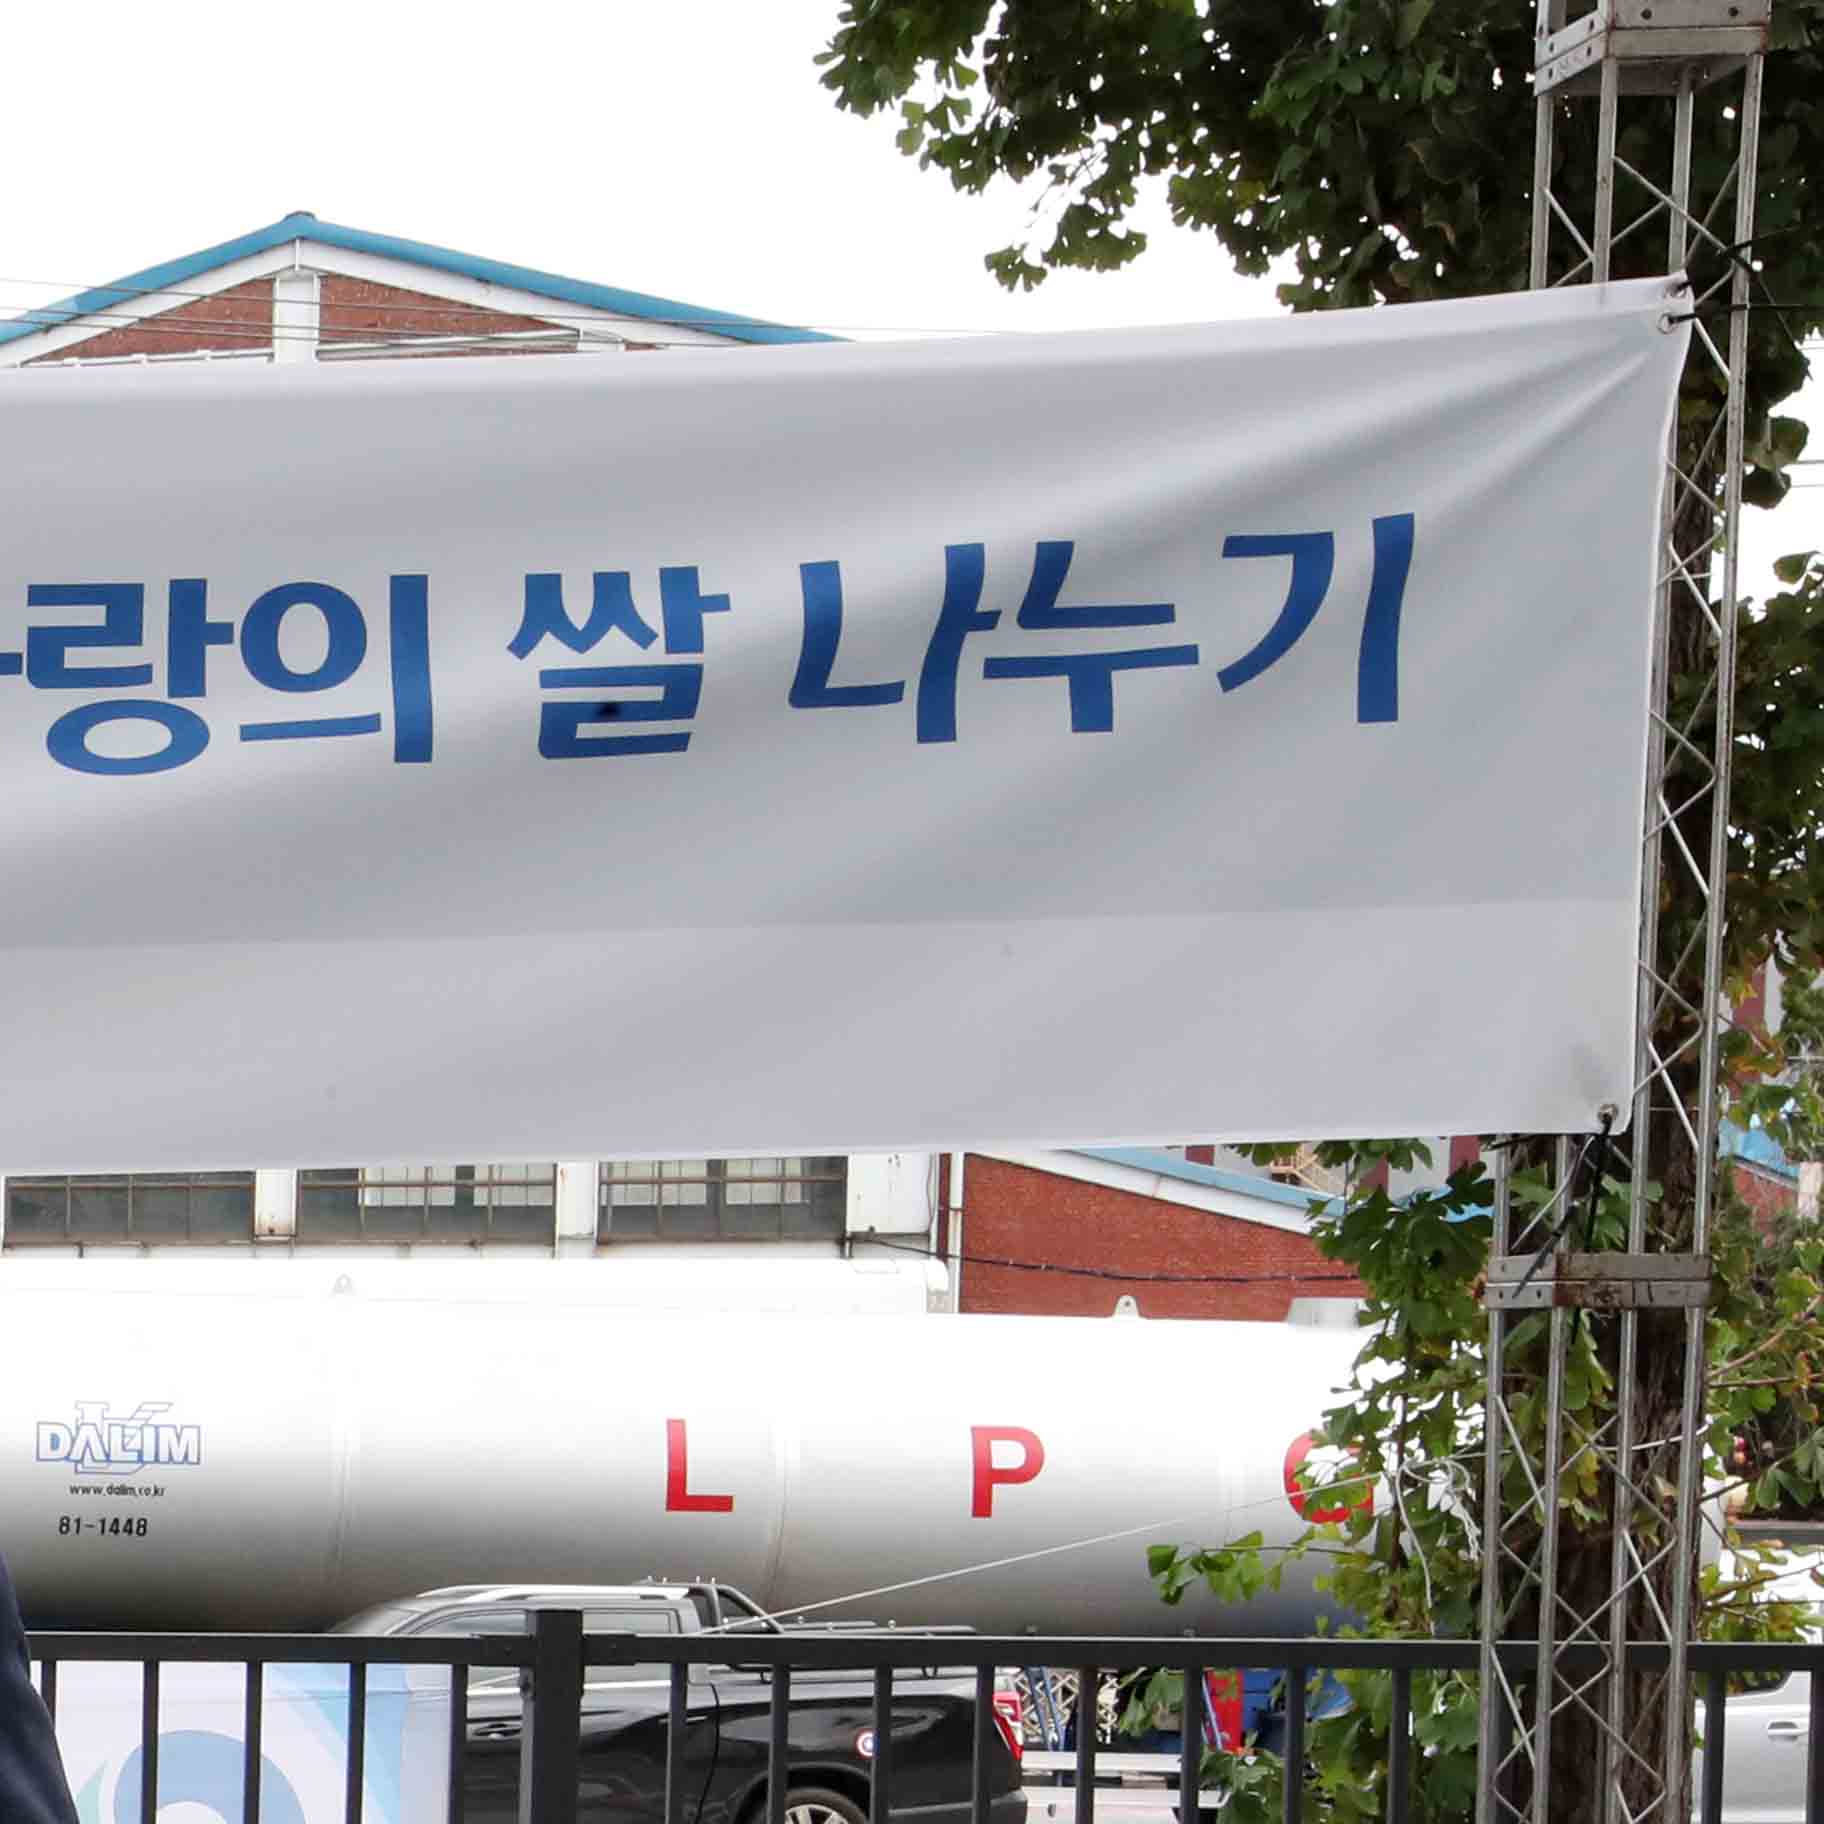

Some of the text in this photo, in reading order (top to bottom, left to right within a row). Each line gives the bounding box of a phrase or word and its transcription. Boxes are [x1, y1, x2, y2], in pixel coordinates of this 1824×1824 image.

[507, 565, 733, 760] 쌀
[790, 511, 1416, 745] 나누기
[36, 1420, 202, 1467] DALIM
[58, 1515, 149, 1538] 81-1448
